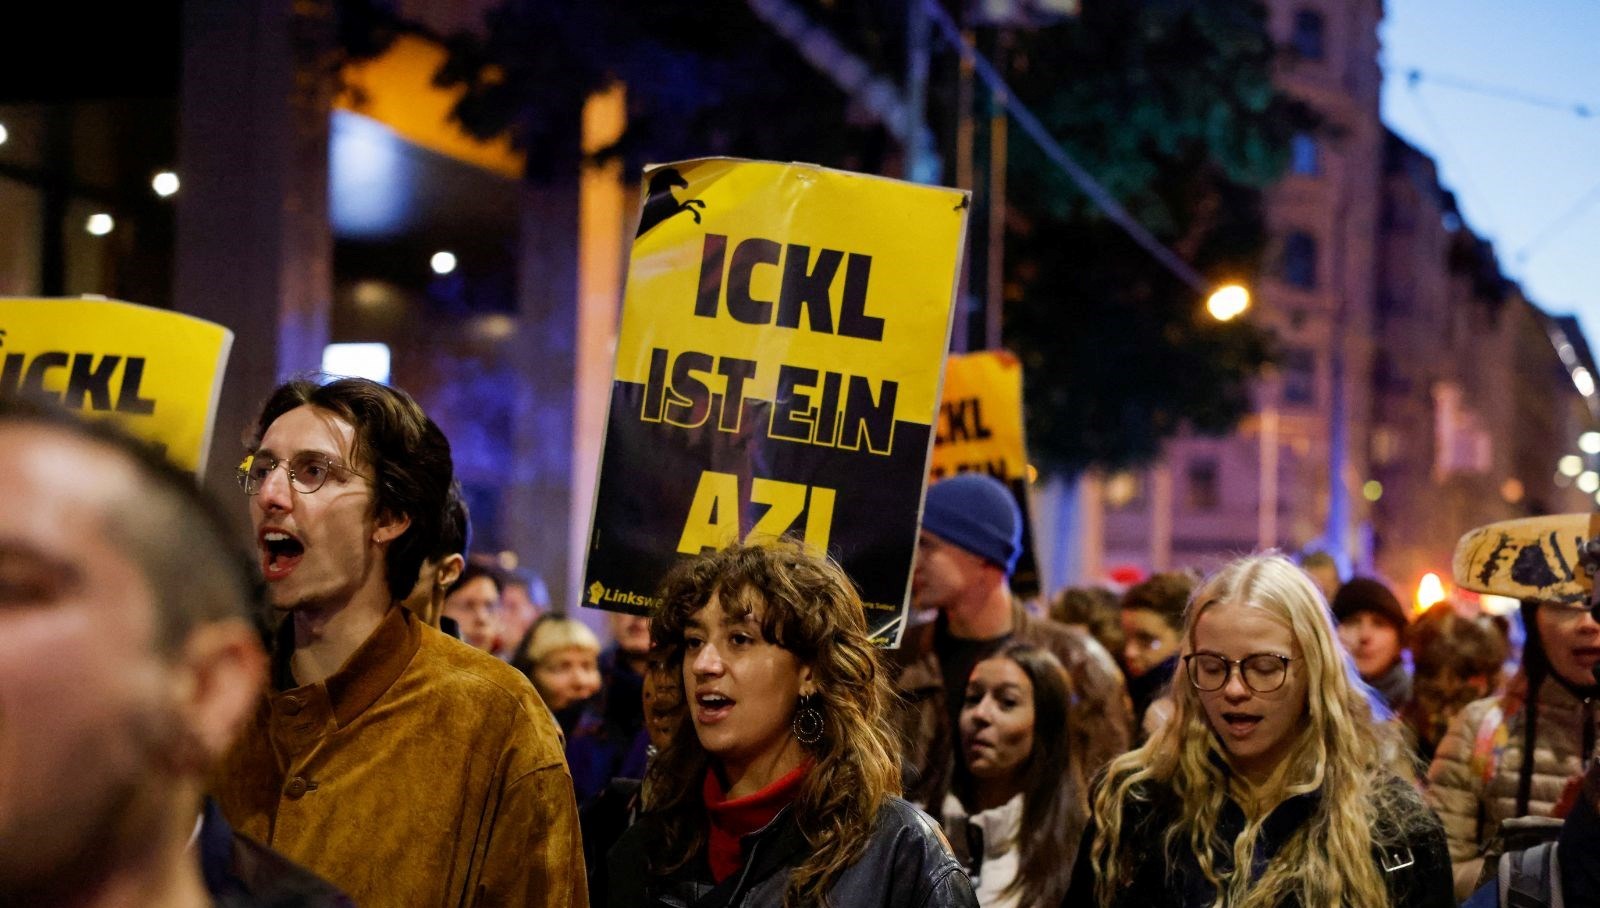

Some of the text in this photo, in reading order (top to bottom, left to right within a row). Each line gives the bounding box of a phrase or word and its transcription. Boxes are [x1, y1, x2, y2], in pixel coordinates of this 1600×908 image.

[694, 233, 885, 341] ICKL
[0, 351, 157, 416] ICKL
[640, 347, 899, 456] IST EIN
